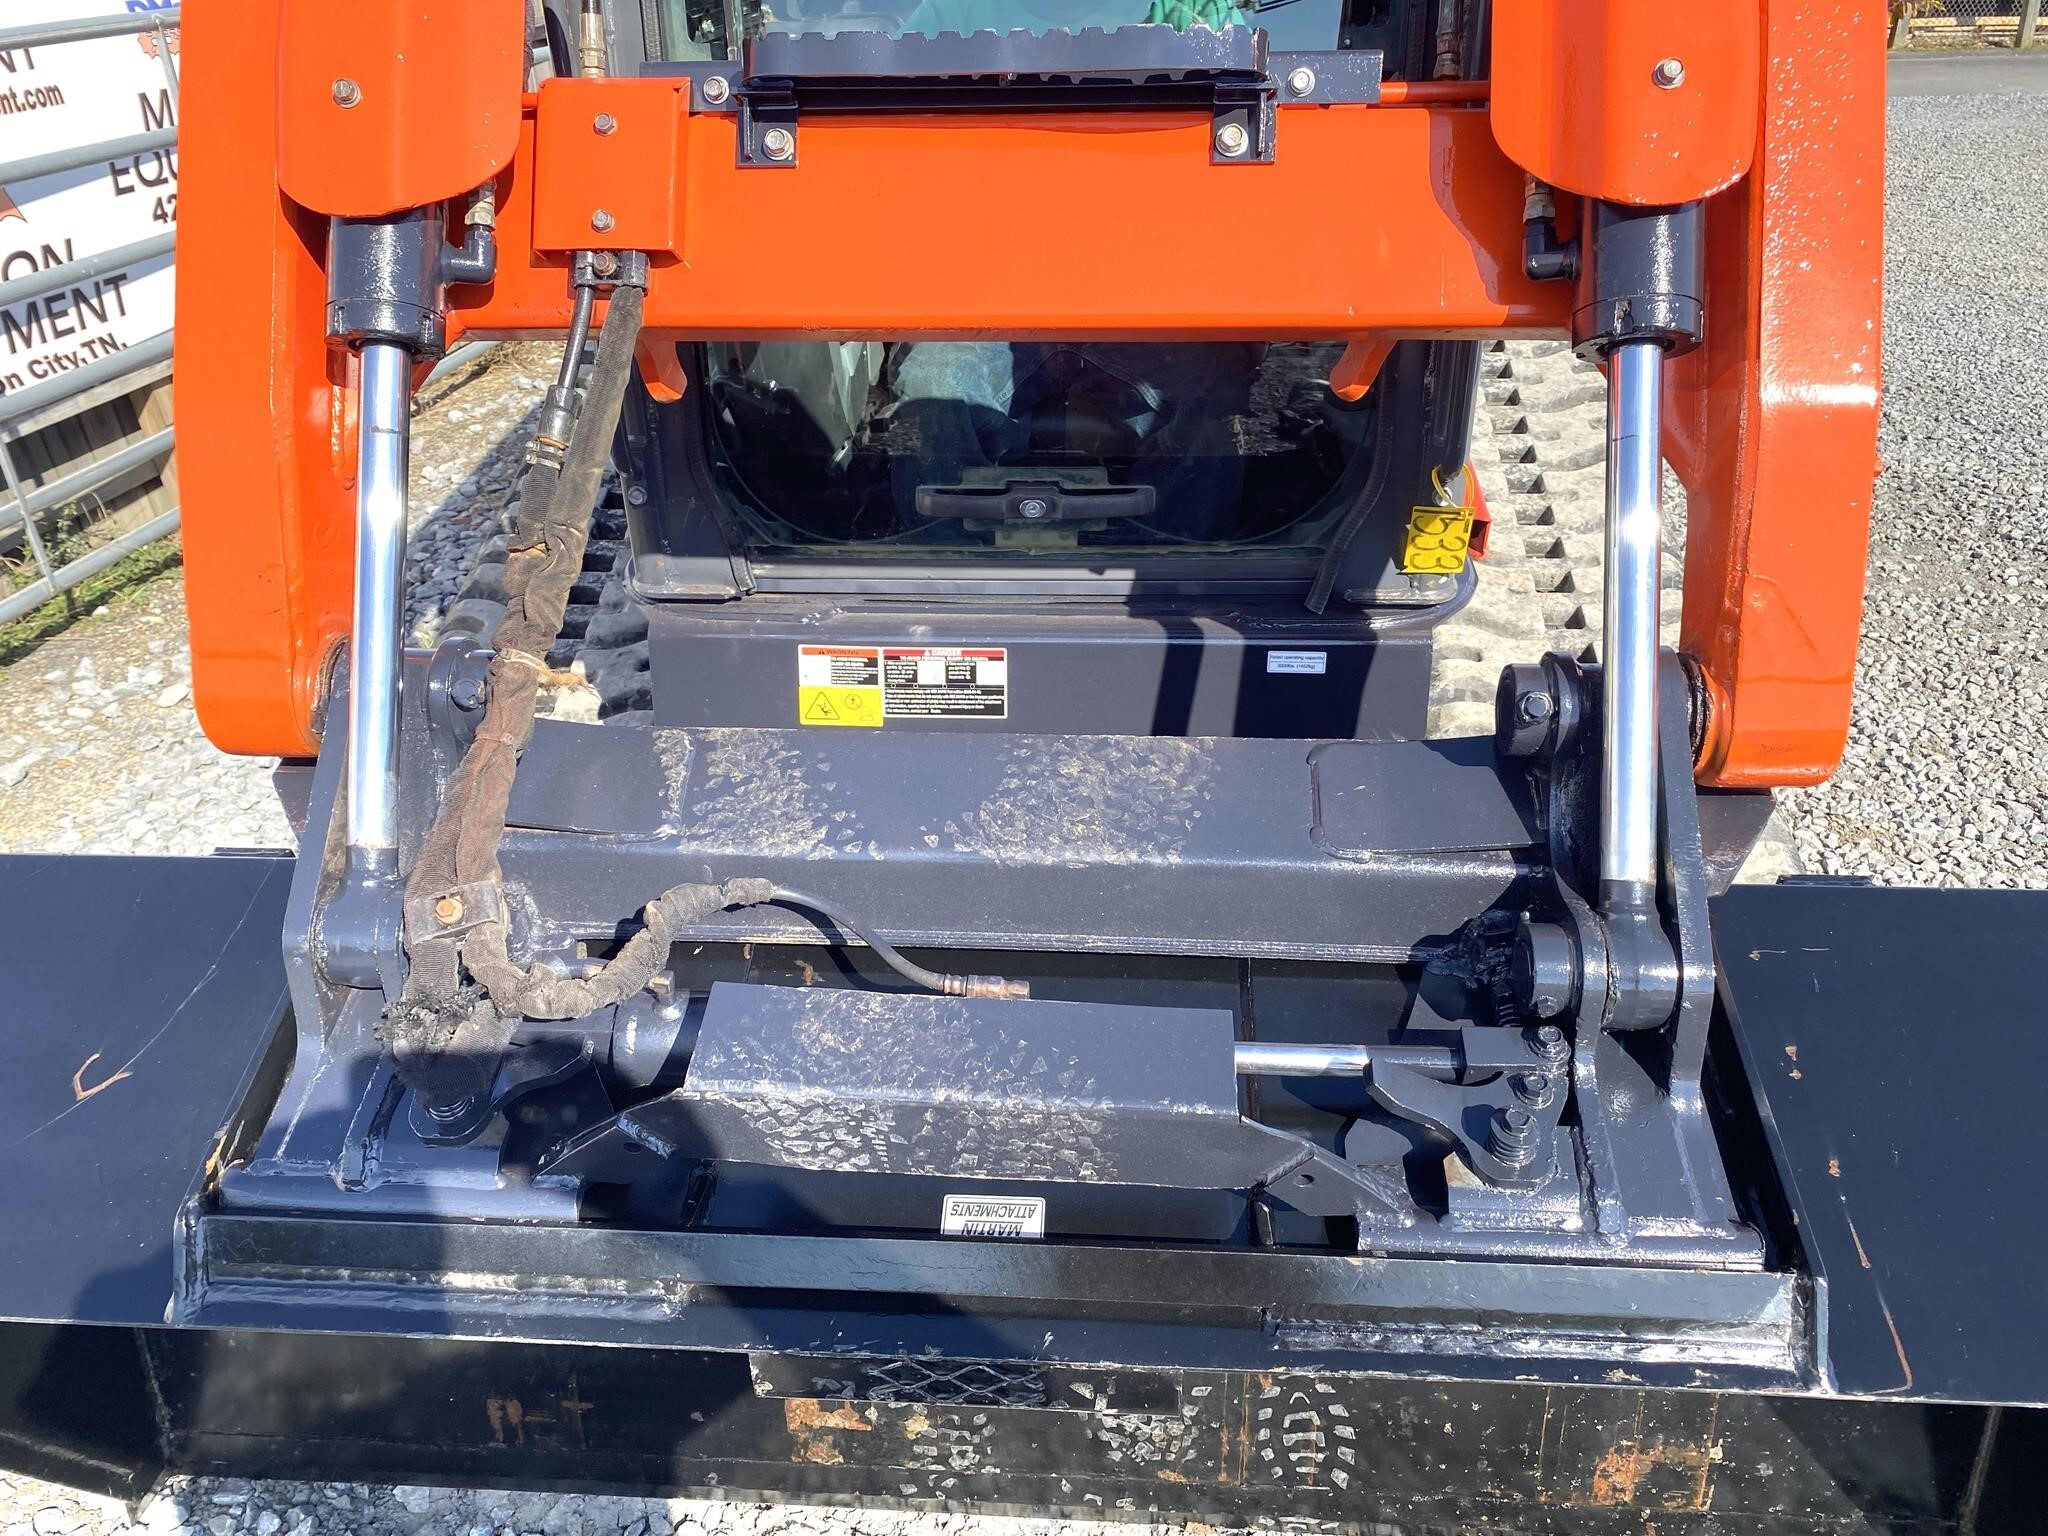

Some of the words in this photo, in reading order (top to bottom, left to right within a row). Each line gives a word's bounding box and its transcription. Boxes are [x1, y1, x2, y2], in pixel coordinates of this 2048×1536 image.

[0, 84, 65, 115] nt.com
[950, 1203, 1037, 1219] ATTACHMENTS
[961, 1222, 1024, 1237] MARTIN
